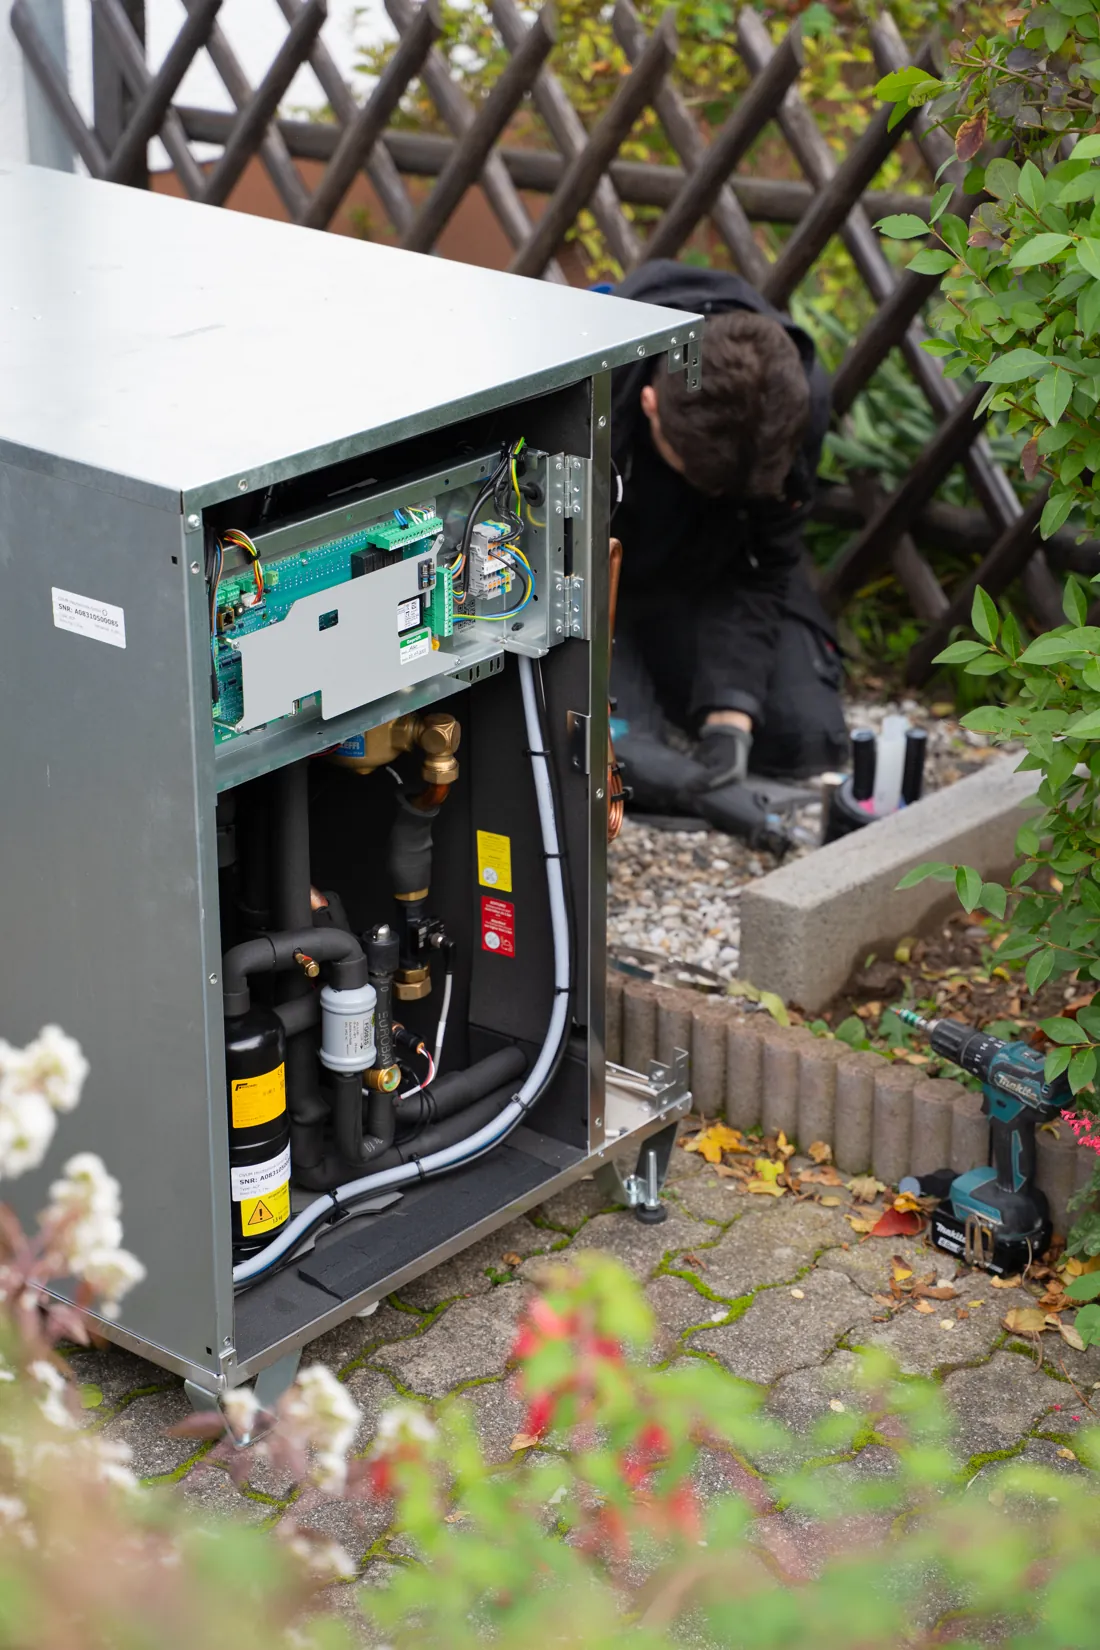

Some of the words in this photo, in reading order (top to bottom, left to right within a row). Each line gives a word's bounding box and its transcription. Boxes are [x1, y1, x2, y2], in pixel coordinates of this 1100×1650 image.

[58, 603, 73, 613] SNR:
[997, 1073, 1039, 1103] Makita
[239, 1177, 258, 1186] SNR:
